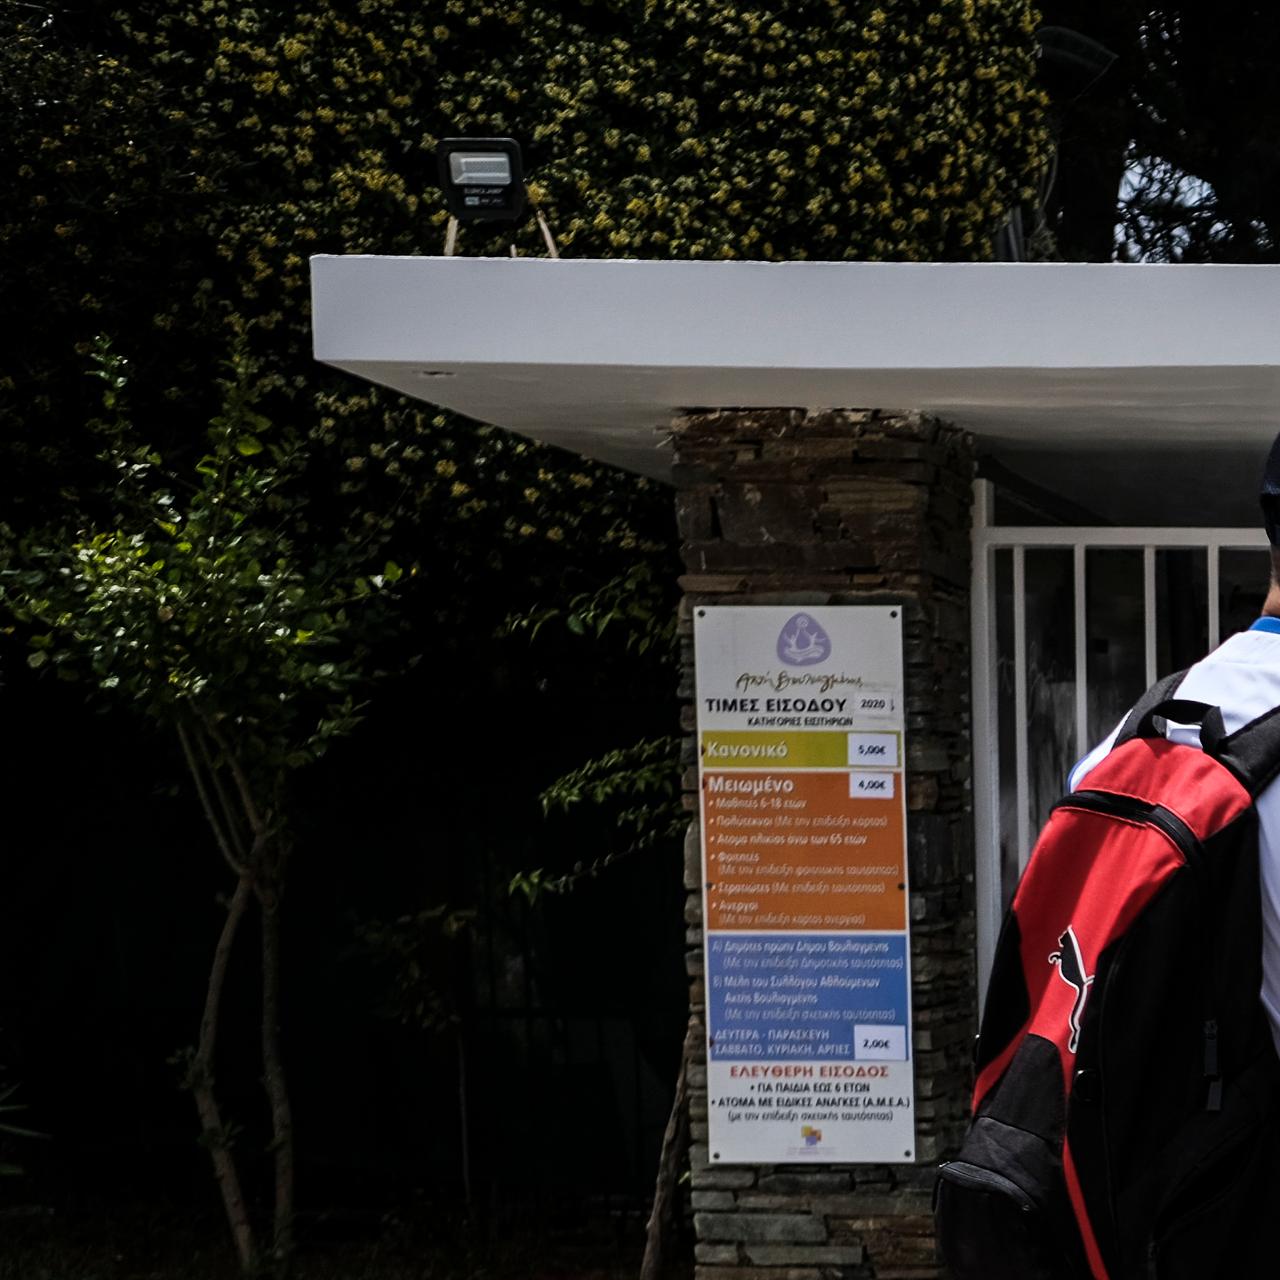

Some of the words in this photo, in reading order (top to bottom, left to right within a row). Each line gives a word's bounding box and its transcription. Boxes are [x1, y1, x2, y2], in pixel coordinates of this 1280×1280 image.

[706, 698, 760, 712] ΤΙΜΕΣ
[767, 698, 846, 712] ΕΙΣΟΔΟΥ
[861, 700, 885, 709] 2020
[708, 741, 788, 758] Κανονικό
[708, 776, 794, 795] Μειωμένο
[715, 1030, 759, 1040] ΔΕΥΤΕΡΑ
[768, 1030, 829, 1041] ΠΑΡΑΣΚΕΥΗ
[730, 1065, 813, 1078] ΕΛΕΥΘΕΡΗ
[820, 1065, 889, 1078] ΕΙΣΟΔΟΣ
[757, 1082, 772, 1093] ΓΙΑ
[775, 1082, 809, 1093] ΠΑΙΔΙΑ
[844, 1083, 870, 1092] ΕΤΩΝ
[718, 1097, 755, 1107] ΑΤΟΜΑ
